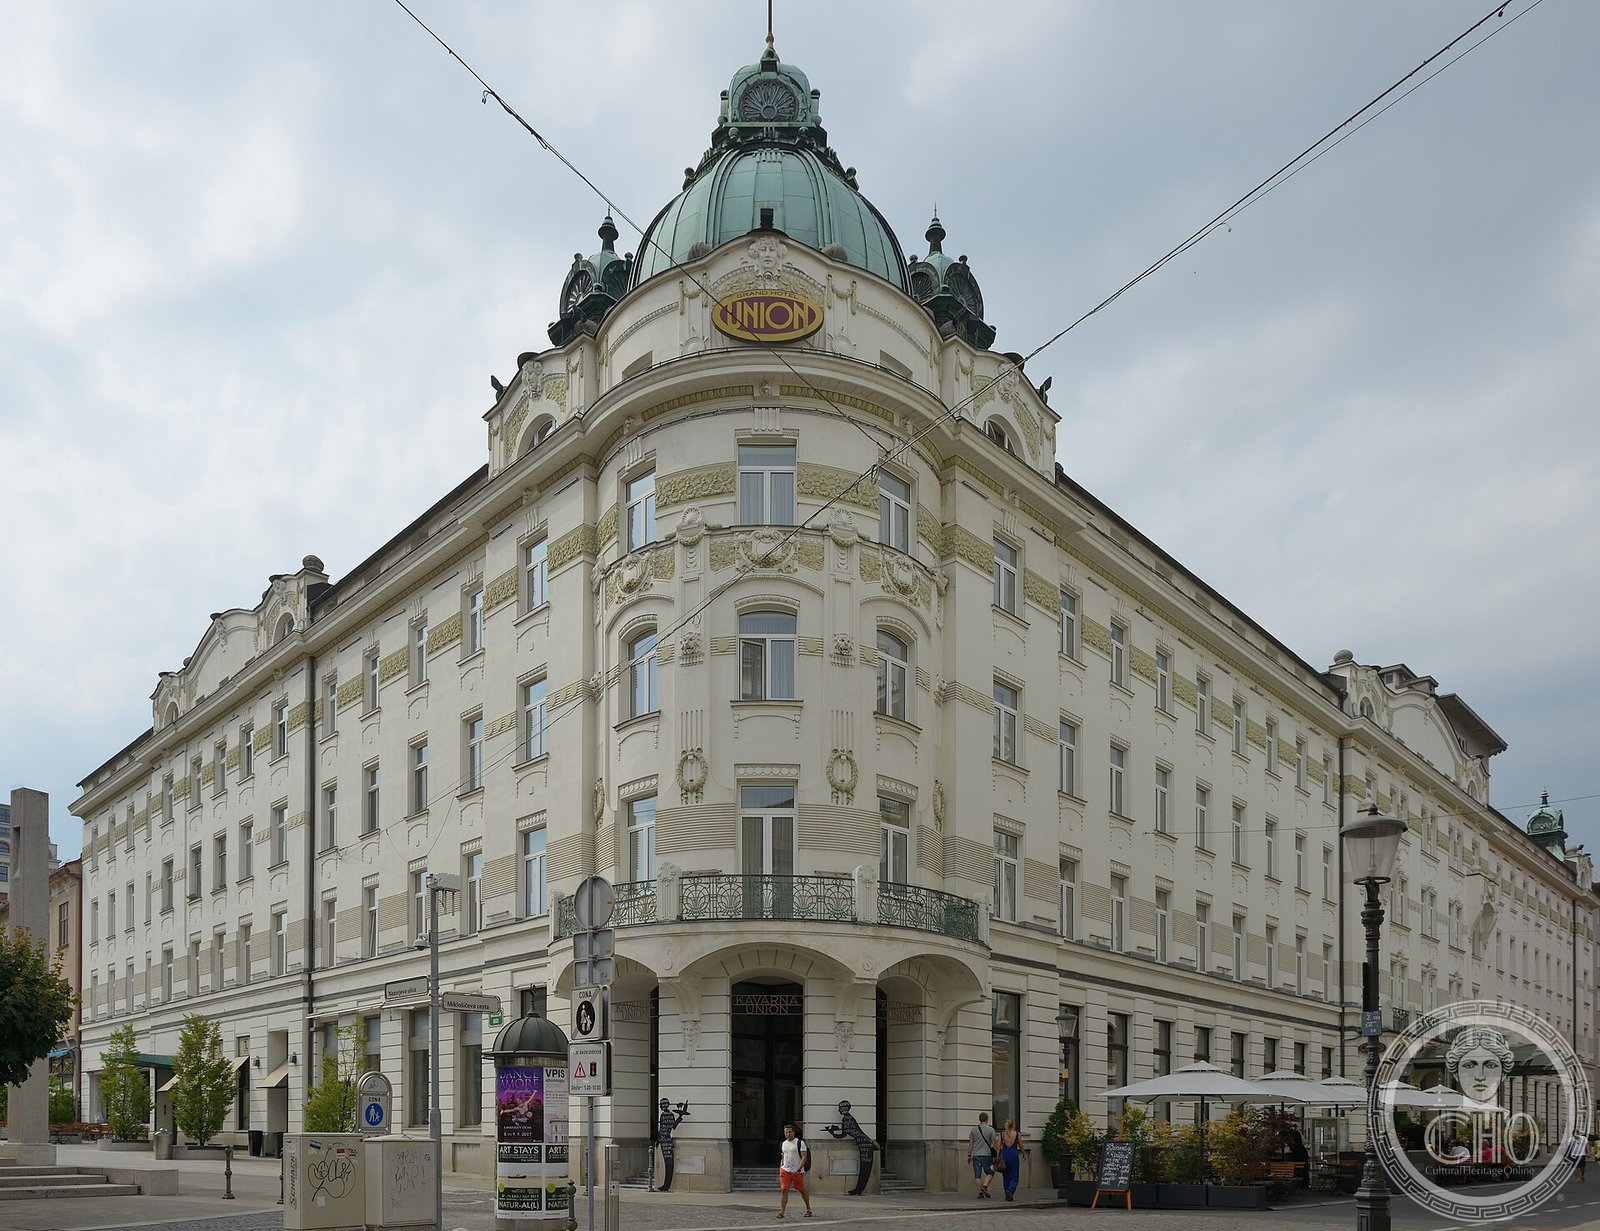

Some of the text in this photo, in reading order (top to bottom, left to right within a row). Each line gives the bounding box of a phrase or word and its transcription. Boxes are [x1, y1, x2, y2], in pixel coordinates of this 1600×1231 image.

[736, 290, 799, 300] GRAND HOTEL
[725, 301, 809, 330] UNION
[579, 990, 592, 999] CONA
[736, 995, 799, 1005] KAVARNA
[477, 1002, 490, 1010] cesta
[745, 1005, 790, 1015] UNION
[499, 1069, 539, 1079] DANCE
[545, 1069, 565, 1078] VPIS
[500, 1079, 539, 1089] AMORE
[499, 1145, 539, 1154] ART STAYS
[548, 1146, 560, 1154] ART
[499, 1201, 540, 1210] NATUR-AL(L)
